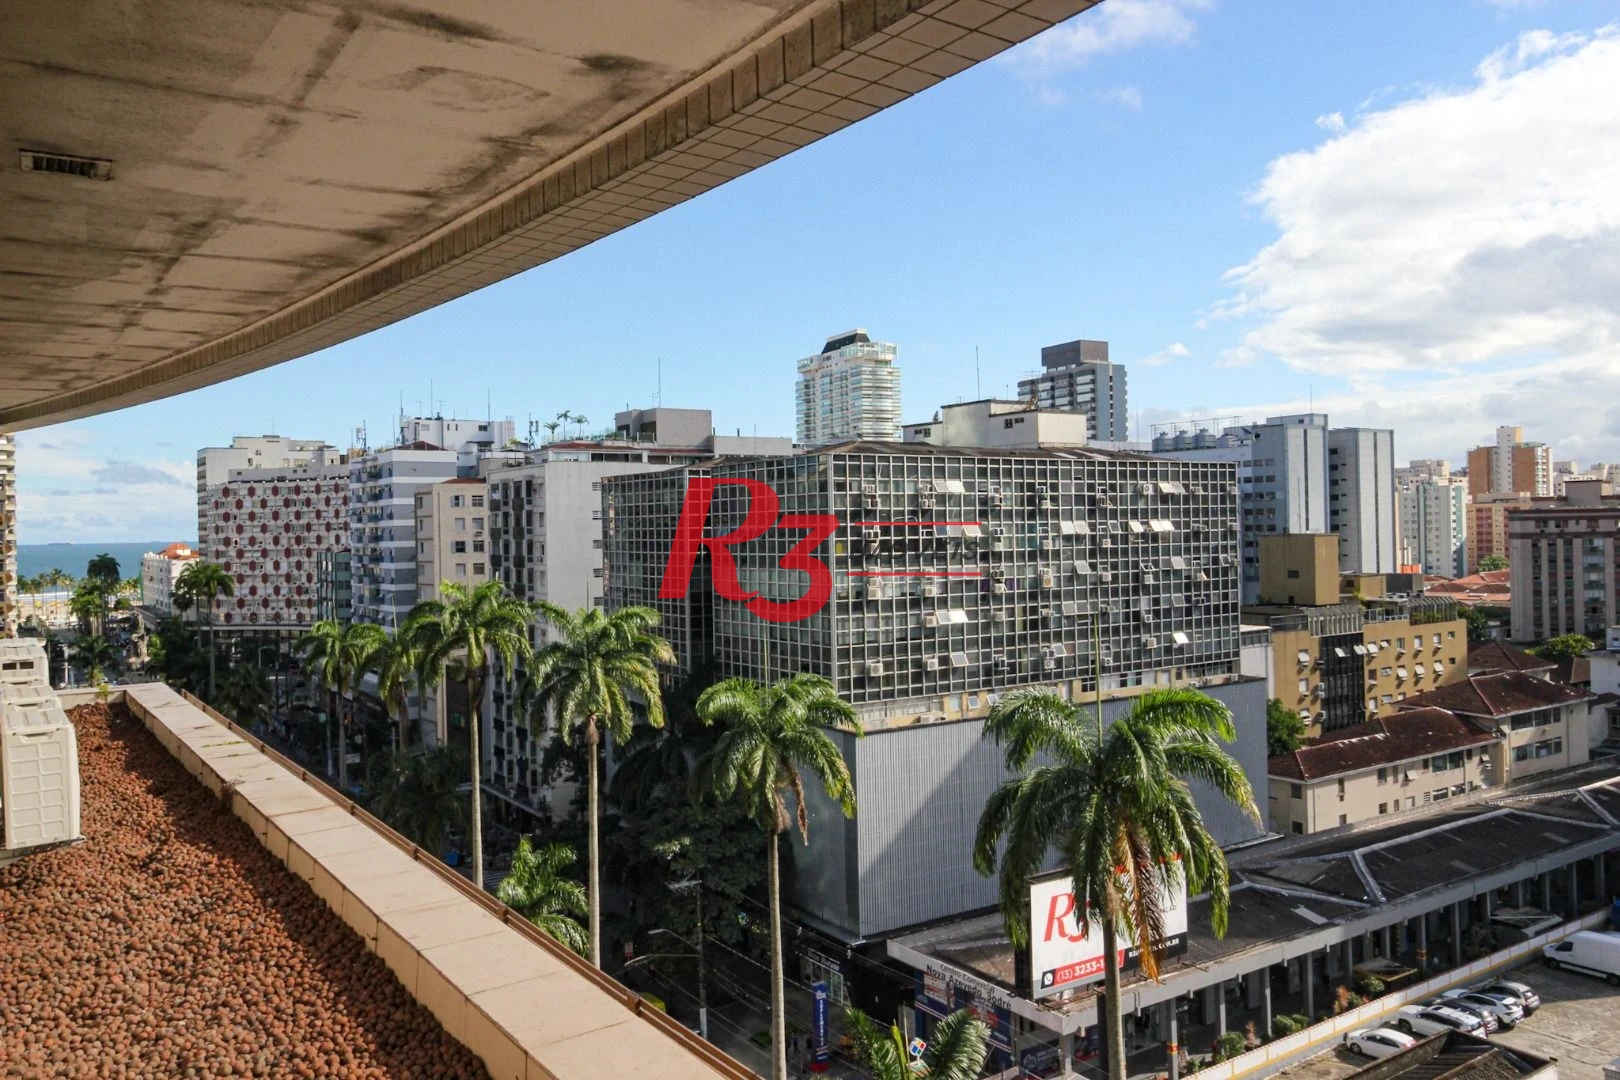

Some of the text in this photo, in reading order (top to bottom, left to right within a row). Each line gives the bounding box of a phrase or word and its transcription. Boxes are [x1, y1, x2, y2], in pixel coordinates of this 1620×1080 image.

[926, 964, 946, 980] Nova
[949, 974, 982, 997] Azevedo
[1057, 968, 1073, 981] (13)
